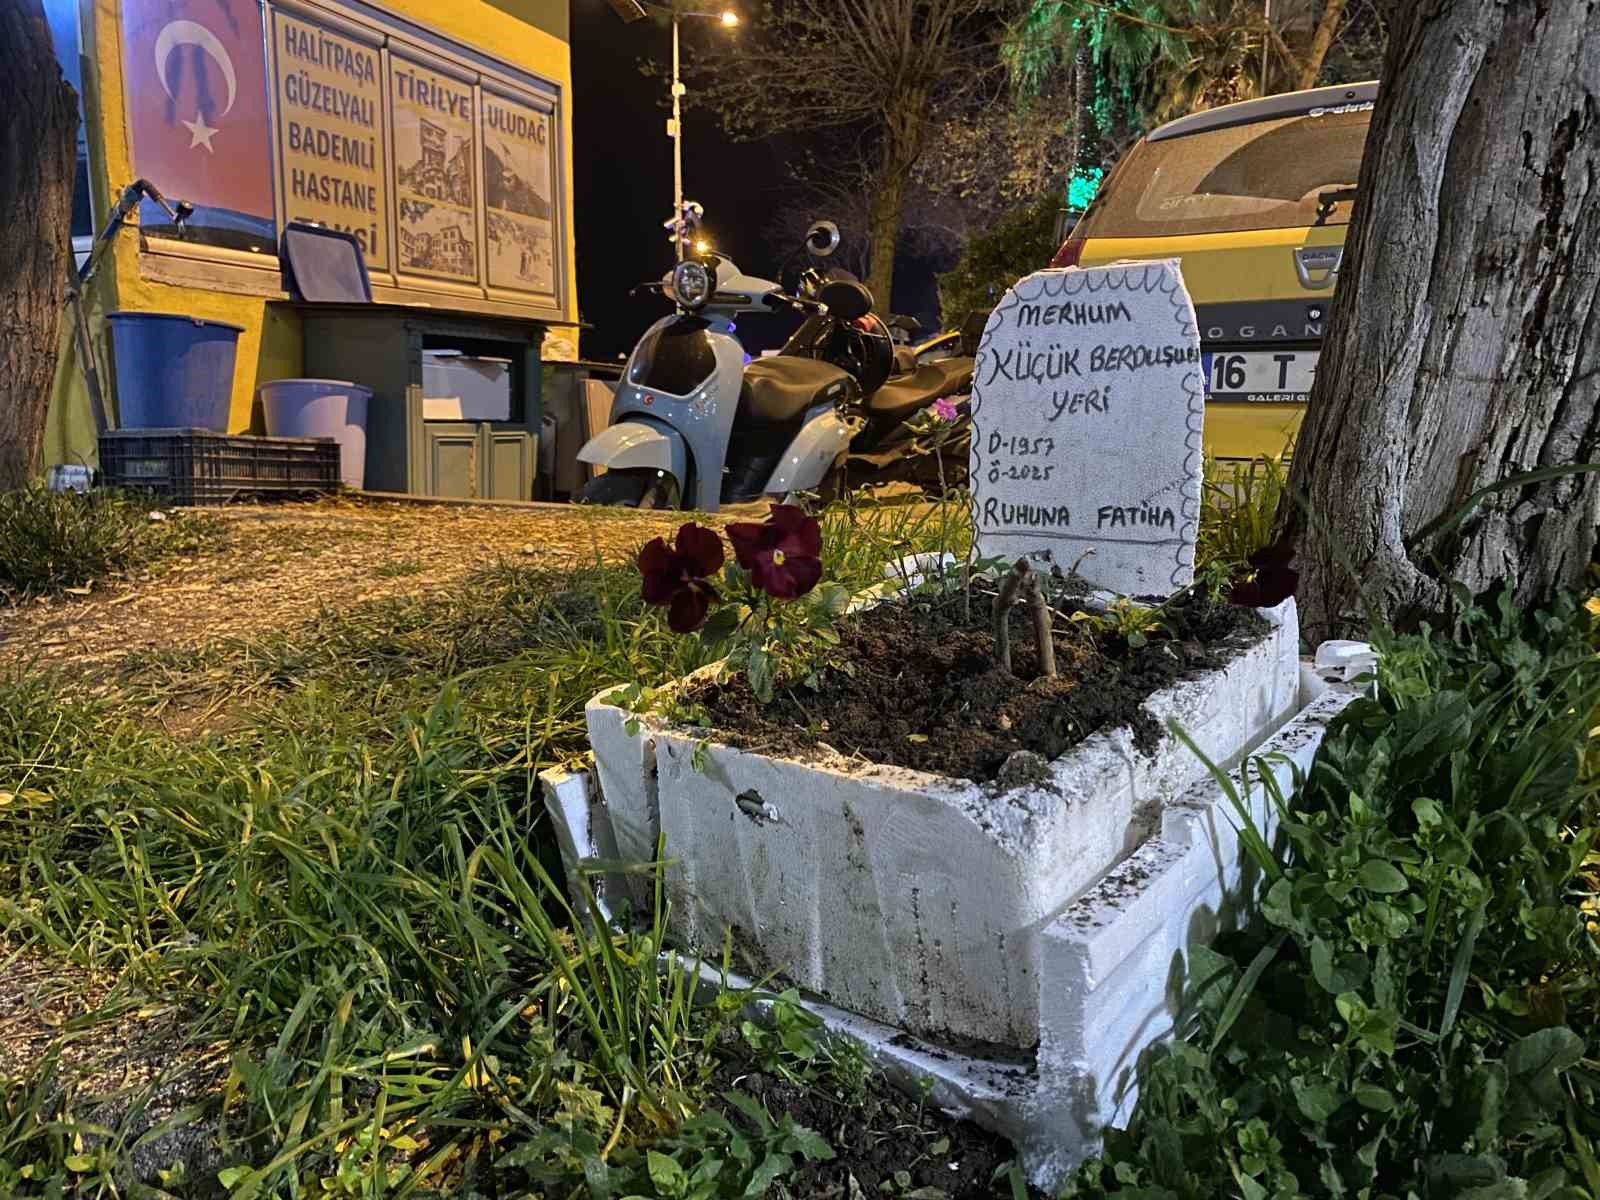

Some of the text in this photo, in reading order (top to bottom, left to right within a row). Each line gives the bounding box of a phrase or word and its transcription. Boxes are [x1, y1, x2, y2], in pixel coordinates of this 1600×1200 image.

[285, 24, 375, 87] HALİTPAŞA
[285, 69, 374, 127] GÜZELYALI
[395, 69, 470, 121] TİRİLYE
[488, 105, 546, 144] ULUDAĞ
[288, 122, 375, 170] BADEMLİ
[292, 168, 377, 212] HASTANE
[1017, 301, 1132, 327] MERHUM
[1207, 323, 1322, 338] OGAN
[986, 340, 1082, 386] KÜÇÜK
[1213, 354, 1295, 390] 16 T
[1050, 385, 1111, 421] YERİ
[983, 497, 1175, 532] RUHUNA FATİHA
